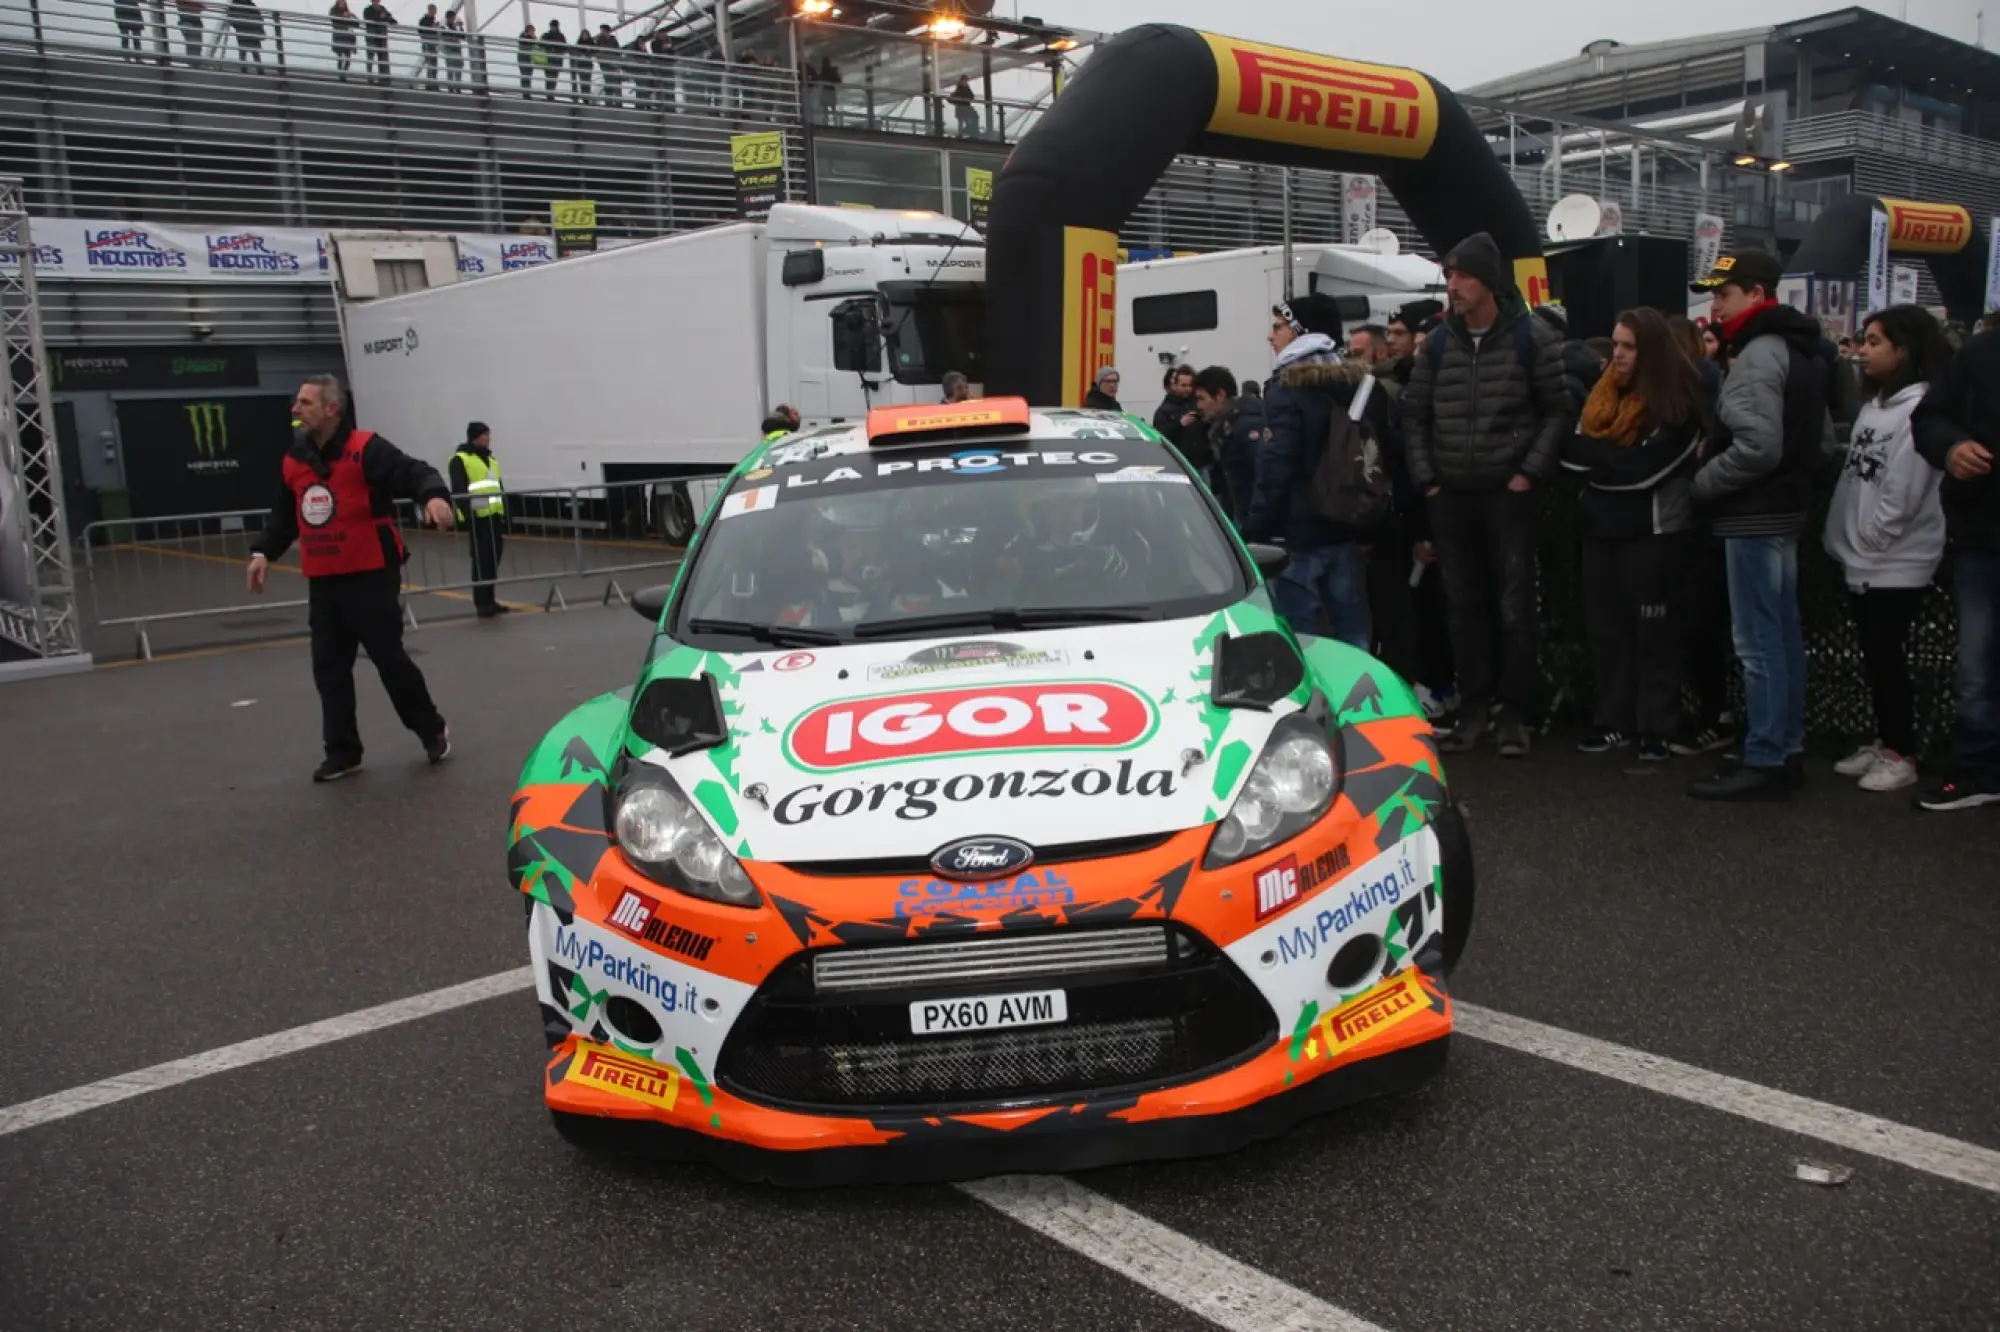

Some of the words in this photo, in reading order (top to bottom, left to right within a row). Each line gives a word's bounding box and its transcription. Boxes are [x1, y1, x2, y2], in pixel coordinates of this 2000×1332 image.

[1231, 48, 1419, 139] PIRELLI
[735, 142, 780, 166] 46
[555, 208, 593, 226] 46
[1893, 206, 1964, 244] PIRELLI
[85, 229, 155, 251] LASER
[206, 233, 270, 254] LASER
[501, 243, 553, 260] LASER
[88, 247, 187, 268] INDUSTRIES
[208, 252, 300, 271] INDUSTRIES
[925, 259, 982, 268] M-SPORT
[364, 337, 403, 354] M-SPORT
[787, 467, 863, 488] LA
[877, 452, 1120, 476] PROTEC
[741, 488, 759, 510] 1
[824, 693, 1111, 754] IGOR
[773, 759, 1178, 825] Gorgonzola
[953, 845, 1009, 869] Ford
[1277, 854, 1416, 965] MyParking.it
[555, 925, 698, 1014] MyParking.it
[924, 1001, 988, 1030] PX60
[998, 995, 1053, 1024] AVM
[1331, 981, 1416, 1043] PIRELLI
[579, 1050, 669, 1098] PIRELLI
